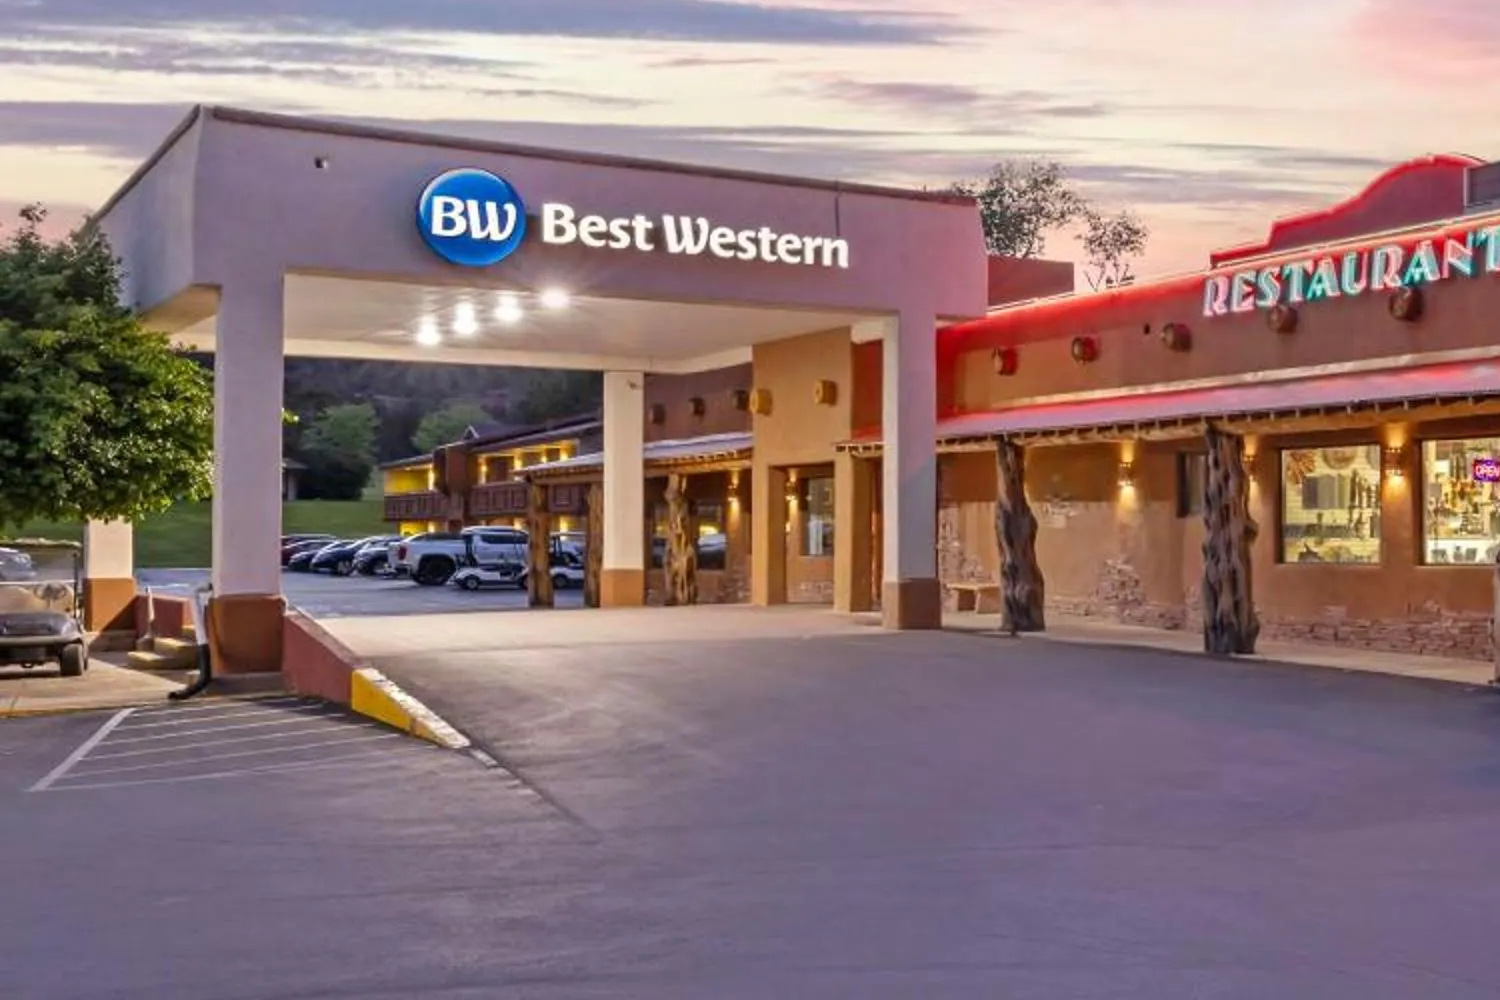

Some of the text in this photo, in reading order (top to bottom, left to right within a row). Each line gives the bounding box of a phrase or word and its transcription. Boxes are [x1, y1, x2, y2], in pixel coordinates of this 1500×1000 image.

[431, 195, 517, 241] BW
[542, 202, 849, 268] Best Western
[1475, 464, 1500, 477] OPEN
